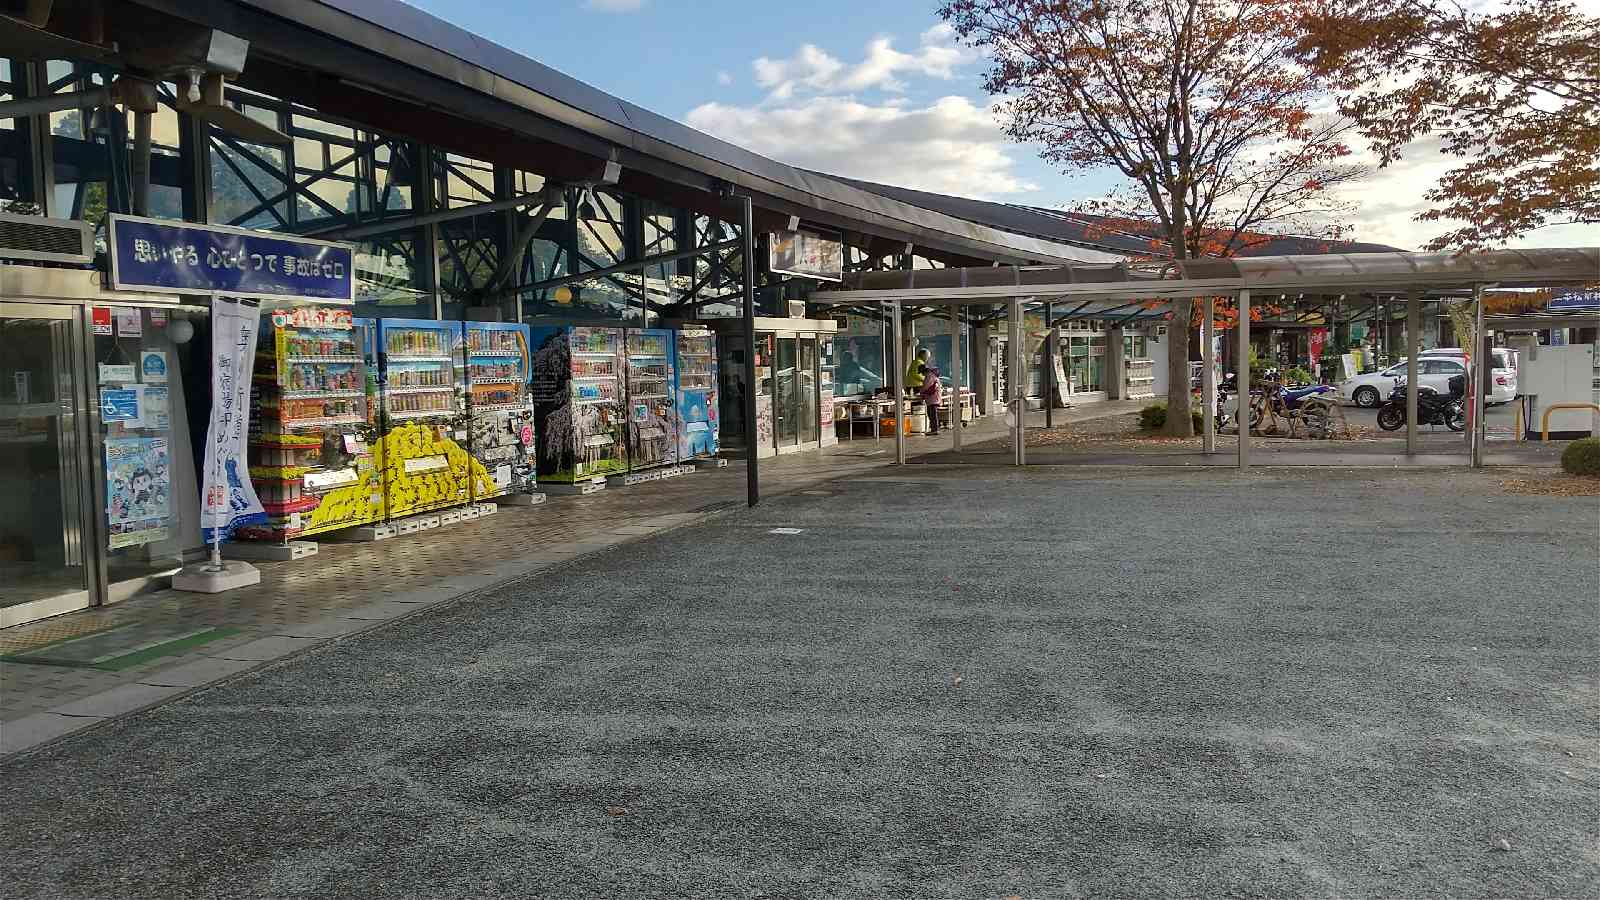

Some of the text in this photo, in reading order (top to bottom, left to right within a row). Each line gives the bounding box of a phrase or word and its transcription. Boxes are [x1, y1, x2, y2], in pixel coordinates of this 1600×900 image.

[133, 238, 199, 266] 思いやる
[283, 255, 344, 279] 事故はゼロ
